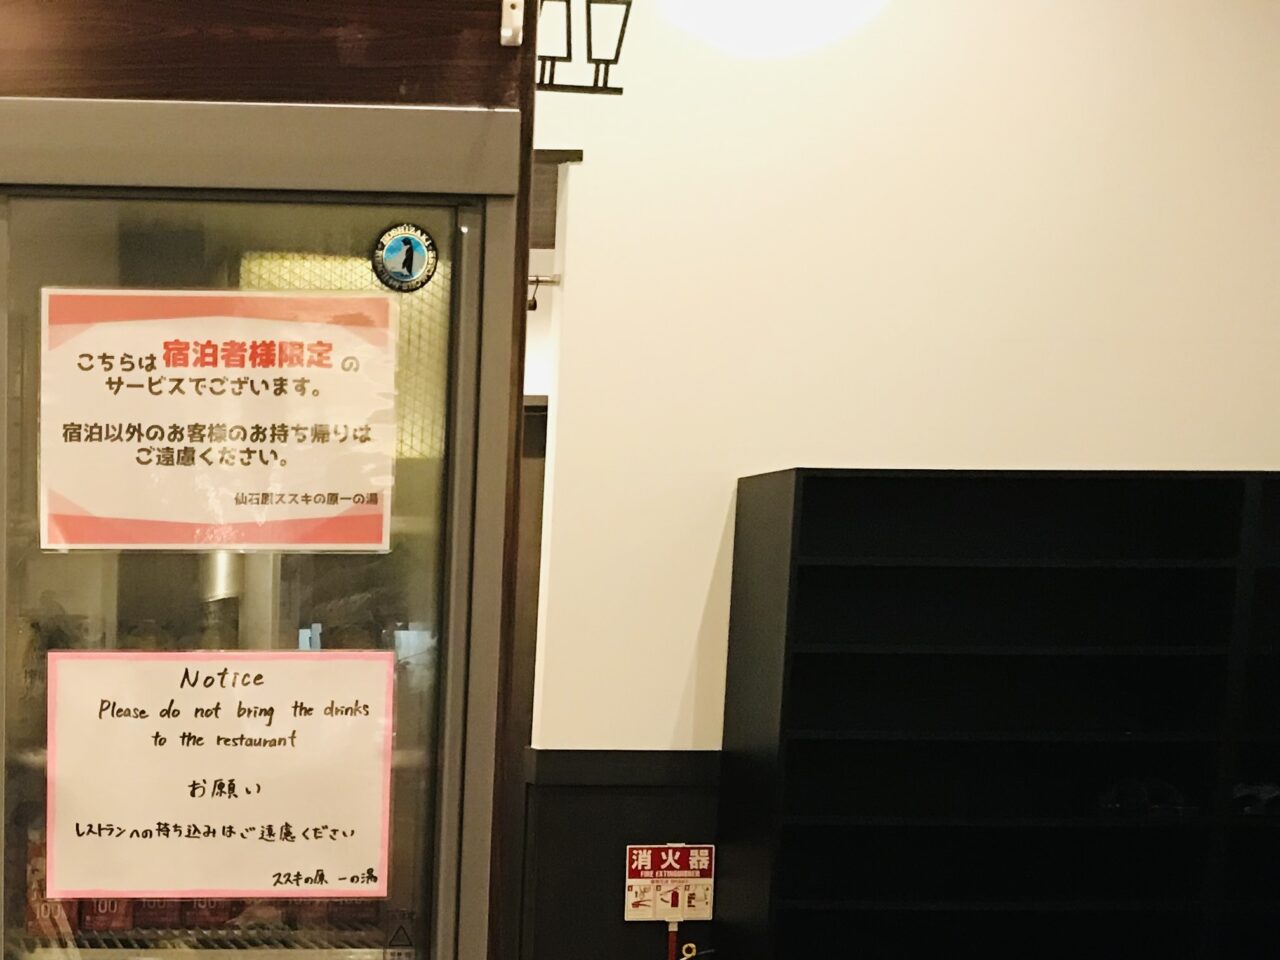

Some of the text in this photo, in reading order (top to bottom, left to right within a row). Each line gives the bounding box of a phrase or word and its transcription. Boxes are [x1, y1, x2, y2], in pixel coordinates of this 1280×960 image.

[105, 376, 321, 397] サービスでございます。
[62, 422, 372, 443] 宿泊以外のお客様のお持ち帰りは
[135, 447, 289, 467] ご遠慮ください。
[179, 667, 265, 689] Notice
[98, 699, 369, 726] Please do not bring the drinks
[152, 730, 297, 748] to the restaurant
[188, 779, 262, 799] お願い
[631, 849, 710, 870] 消火器
